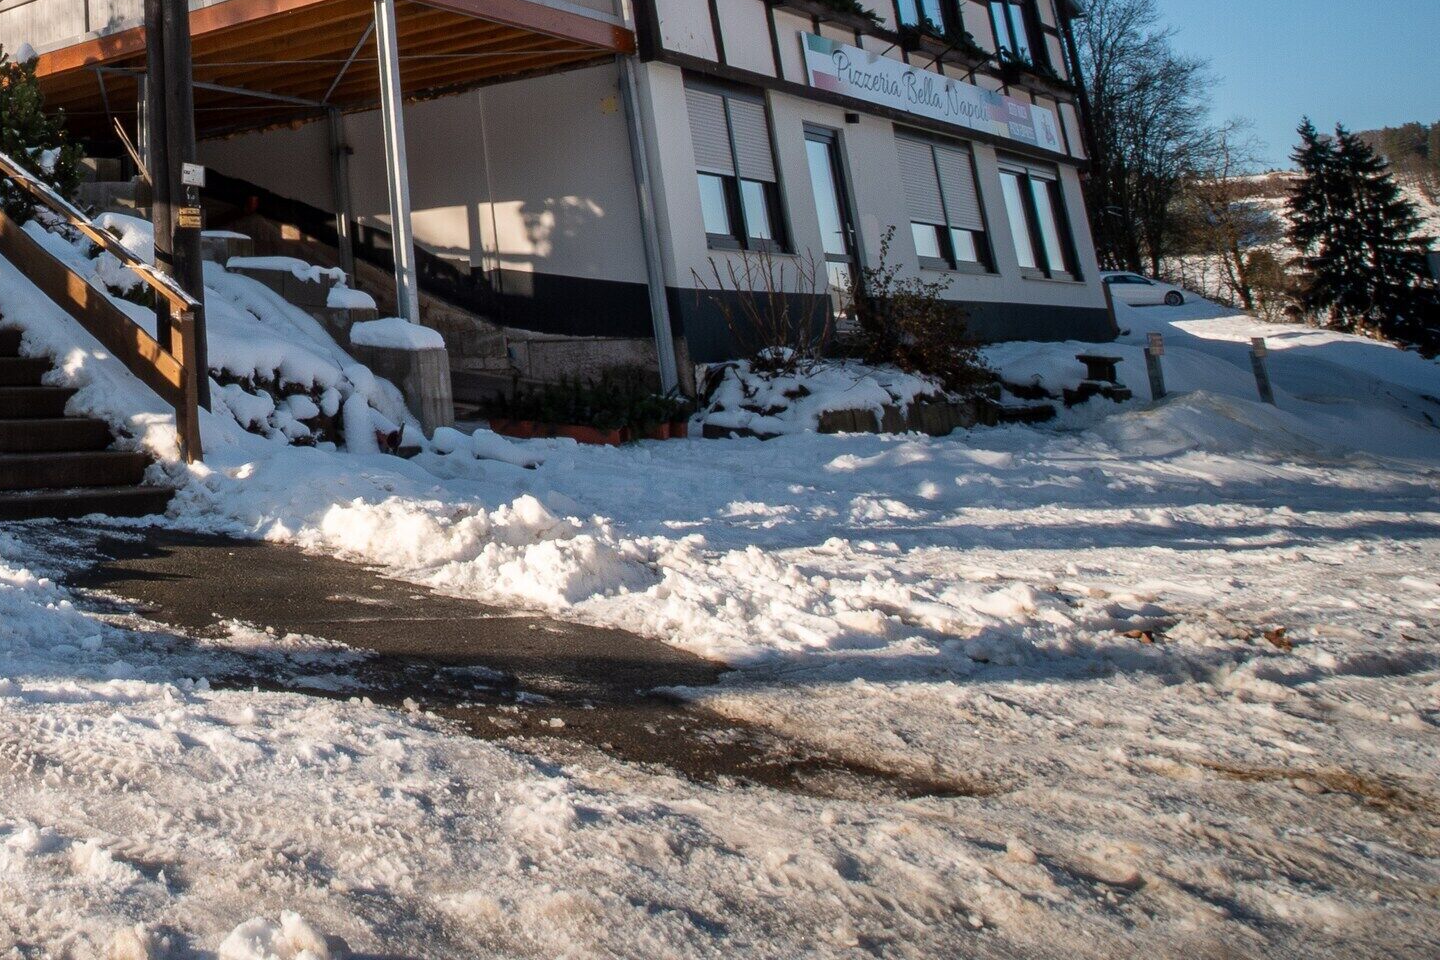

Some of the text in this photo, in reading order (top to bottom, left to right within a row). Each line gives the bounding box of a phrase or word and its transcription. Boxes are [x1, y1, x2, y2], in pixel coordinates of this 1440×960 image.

[832, 49, 902, 97] Pizzeria
[902, 71, 943, 104] Bella
[944, 84, 989, 128] Napoli
